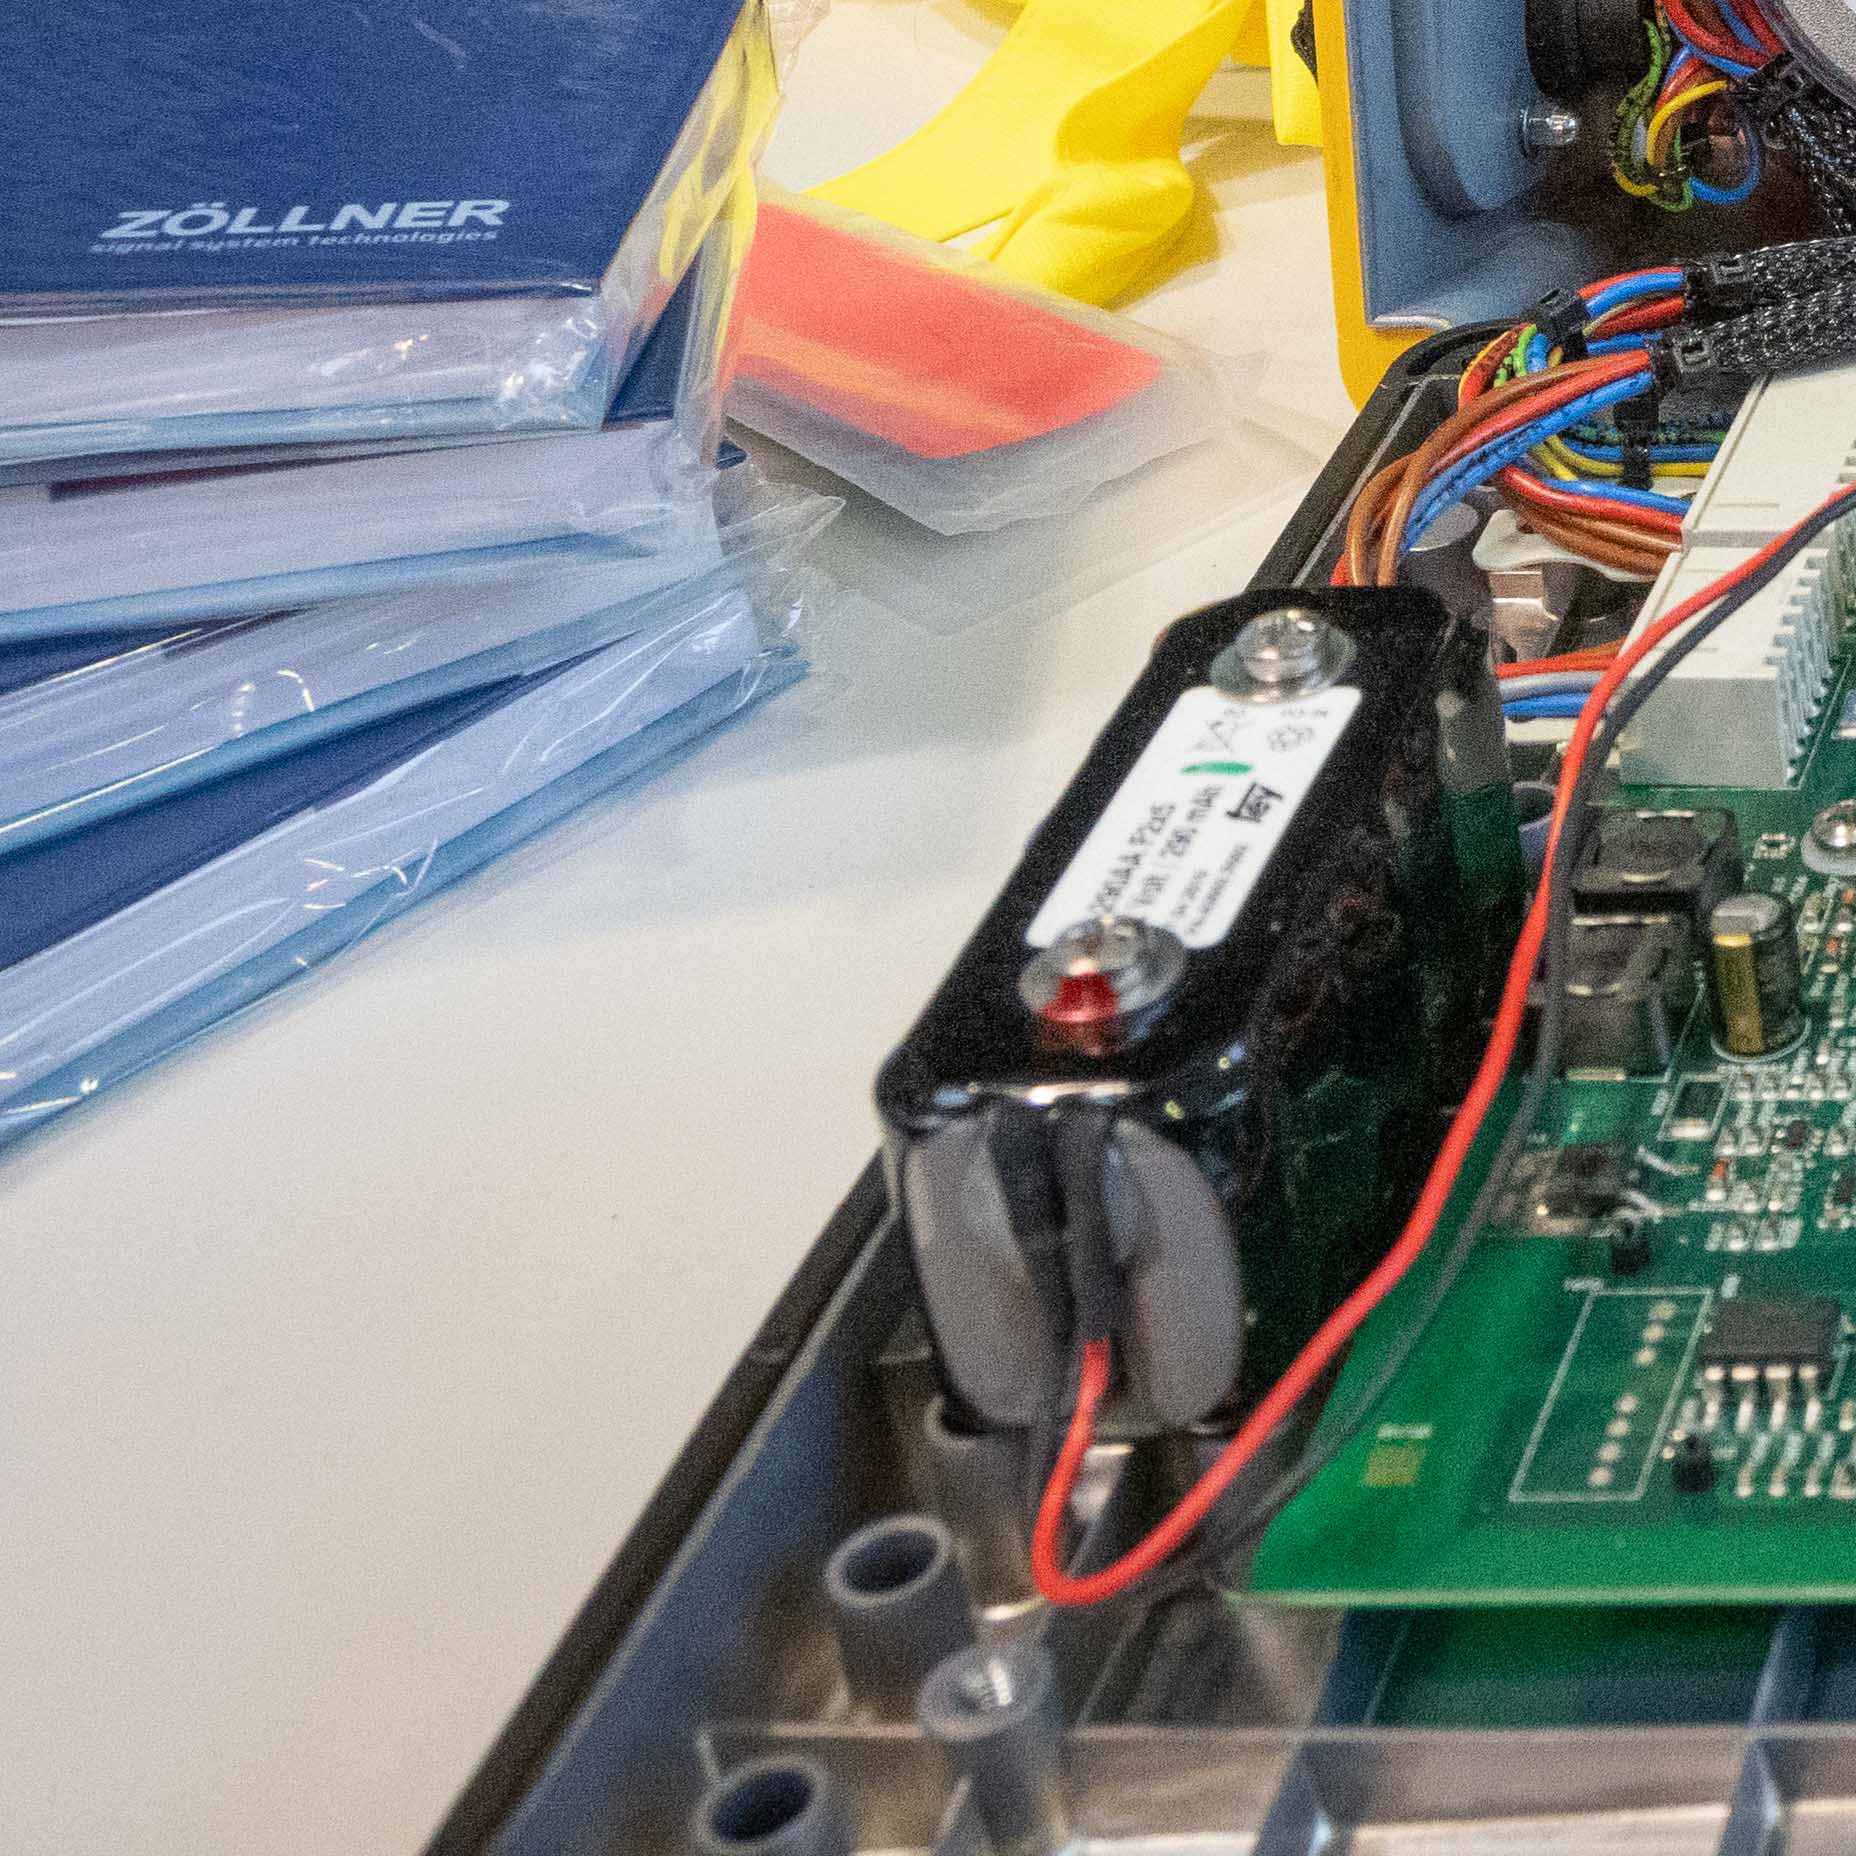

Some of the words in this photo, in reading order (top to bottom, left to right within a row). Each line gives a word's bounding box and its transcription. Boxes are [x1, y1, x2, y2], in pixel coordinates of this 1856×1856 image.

[102, 199, 510, 240] ZÖLLNER
[89, 238, 186, 255] signal
[188, 234, 301, 253] system
[308, 229, 500, 247] technologies
